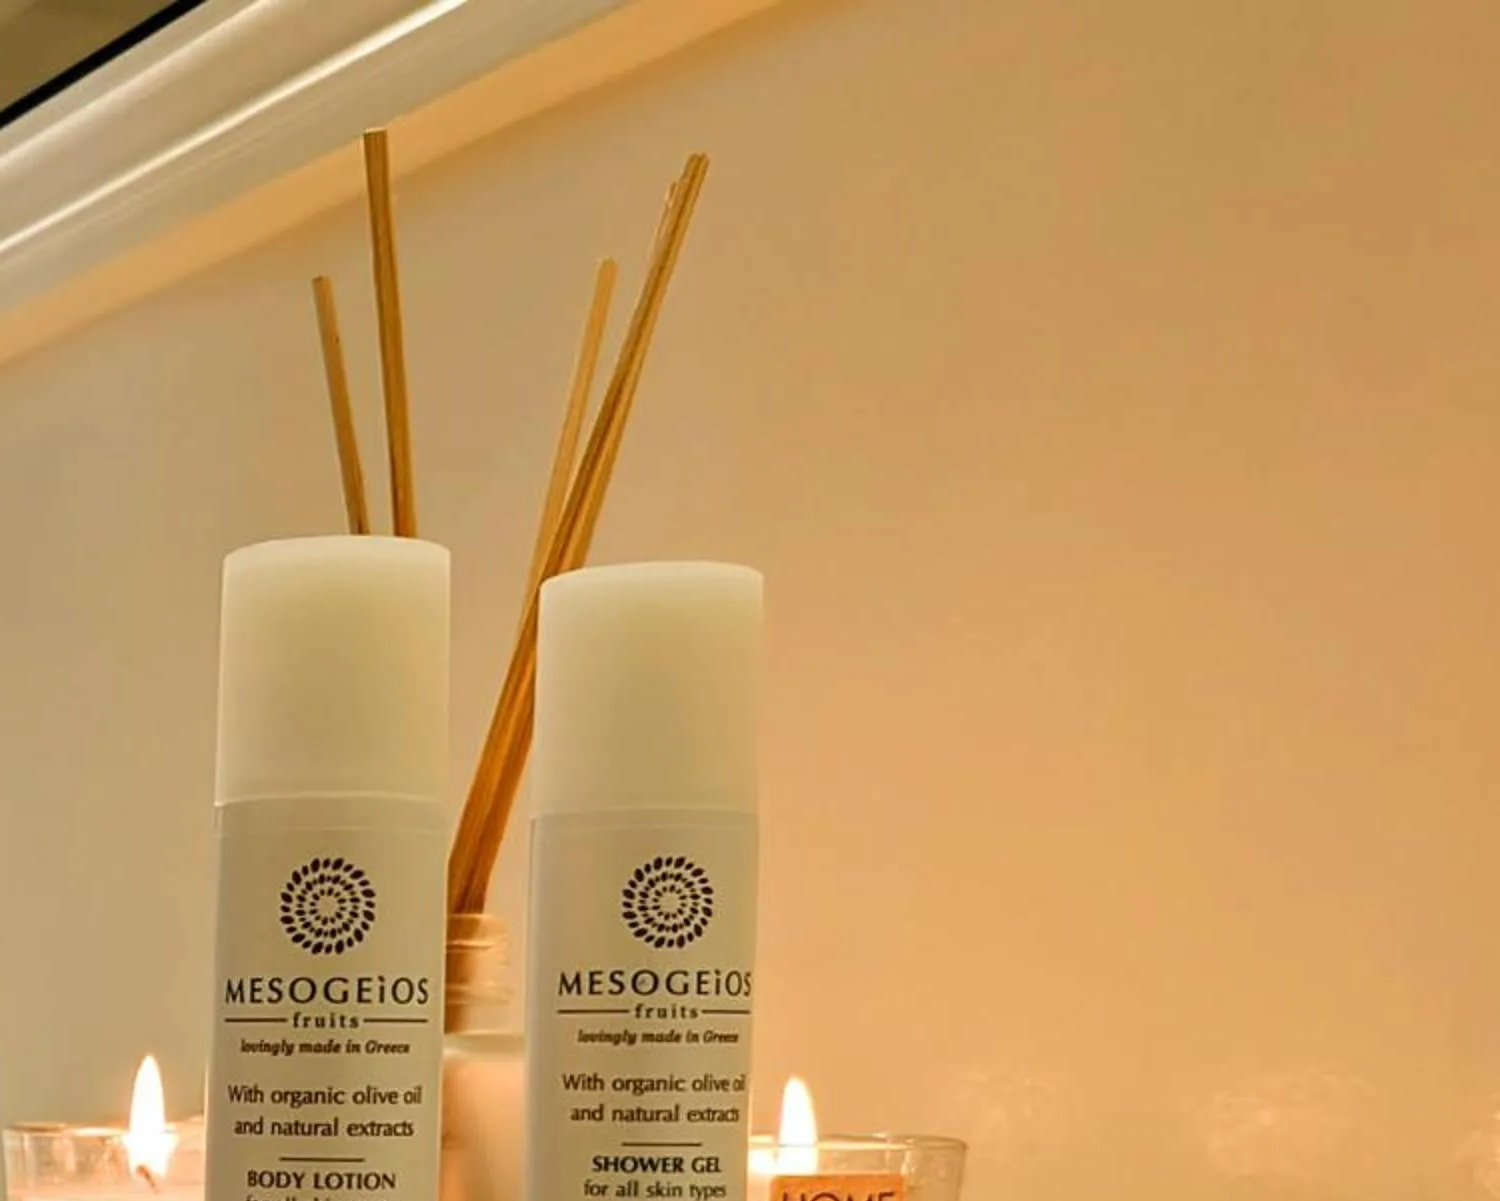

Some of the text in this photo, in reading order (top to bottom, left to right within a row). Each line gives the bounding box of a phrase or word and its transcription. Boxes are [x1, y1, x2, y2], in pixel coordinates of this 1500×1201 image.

[635, 1004, 699, 1019] fruits
[292, 1013, 359, 1028] fruits
[577, 1029, 636, 1045] lovingly
[641, 1030, 681, 1043] made
[685, 1031, 699, 1043] in
[241, 1040, 410, 1056] lovingly made in Greece
[562, 1073, 746, 1096] With organic olive oil
[228, 1084, 422, 1108] With organic olive oil
[571, 1105, 739, 1122] and natural extracts
[234, 1117, 414, 1136] and natural extracts
[592, 1156, 721, 1173] SHOWER GEL
[247, 1170, 396, 1190] BODY LOTION
[584, 1182, 726, 1200] for all skin types
